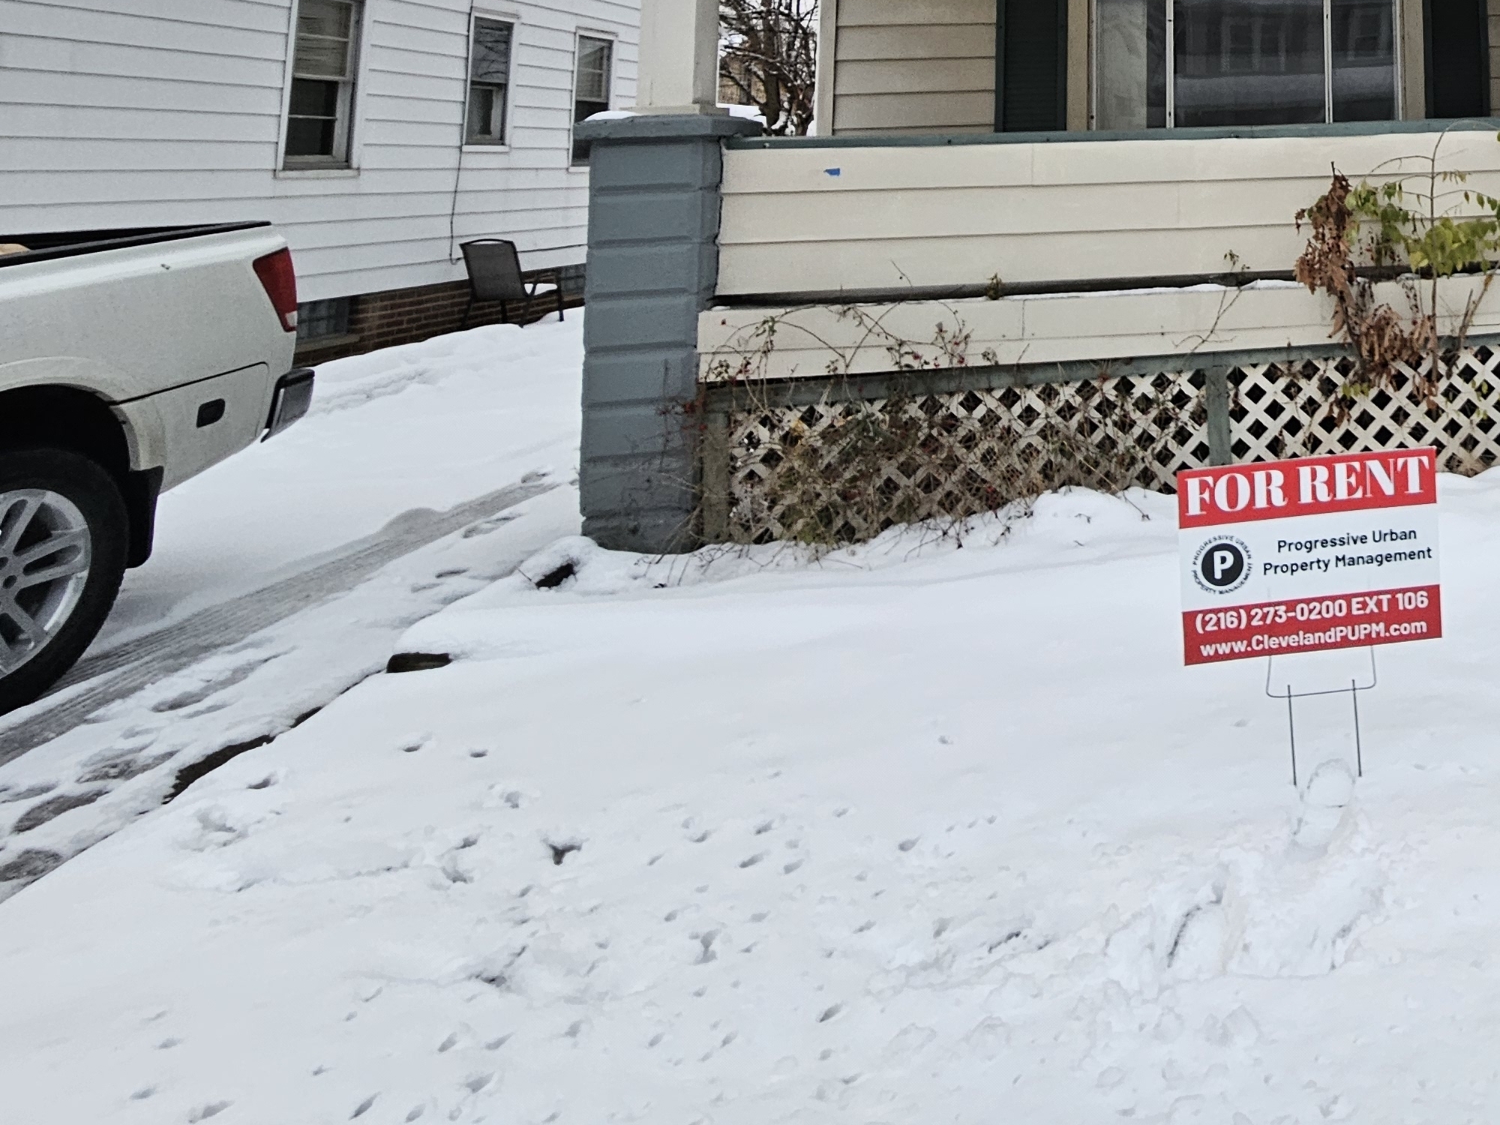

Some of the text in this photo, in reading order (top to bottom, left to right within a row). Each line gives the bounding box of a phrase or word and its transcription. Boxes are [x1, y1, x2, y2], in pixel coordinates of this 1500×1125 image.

[1185, 455, 1430, 516] FOR RENT
[1277, 529, 1417, 554] Progressive Urban
[1213, 550, 1234, 580] P
[1263, 547, 1432, 576] Property Management
[1195, 590, 1428, 634] (216) 273-0200 EXT 106
[1200, 621, 1427, 657] www.ClevelandPUPM.com
